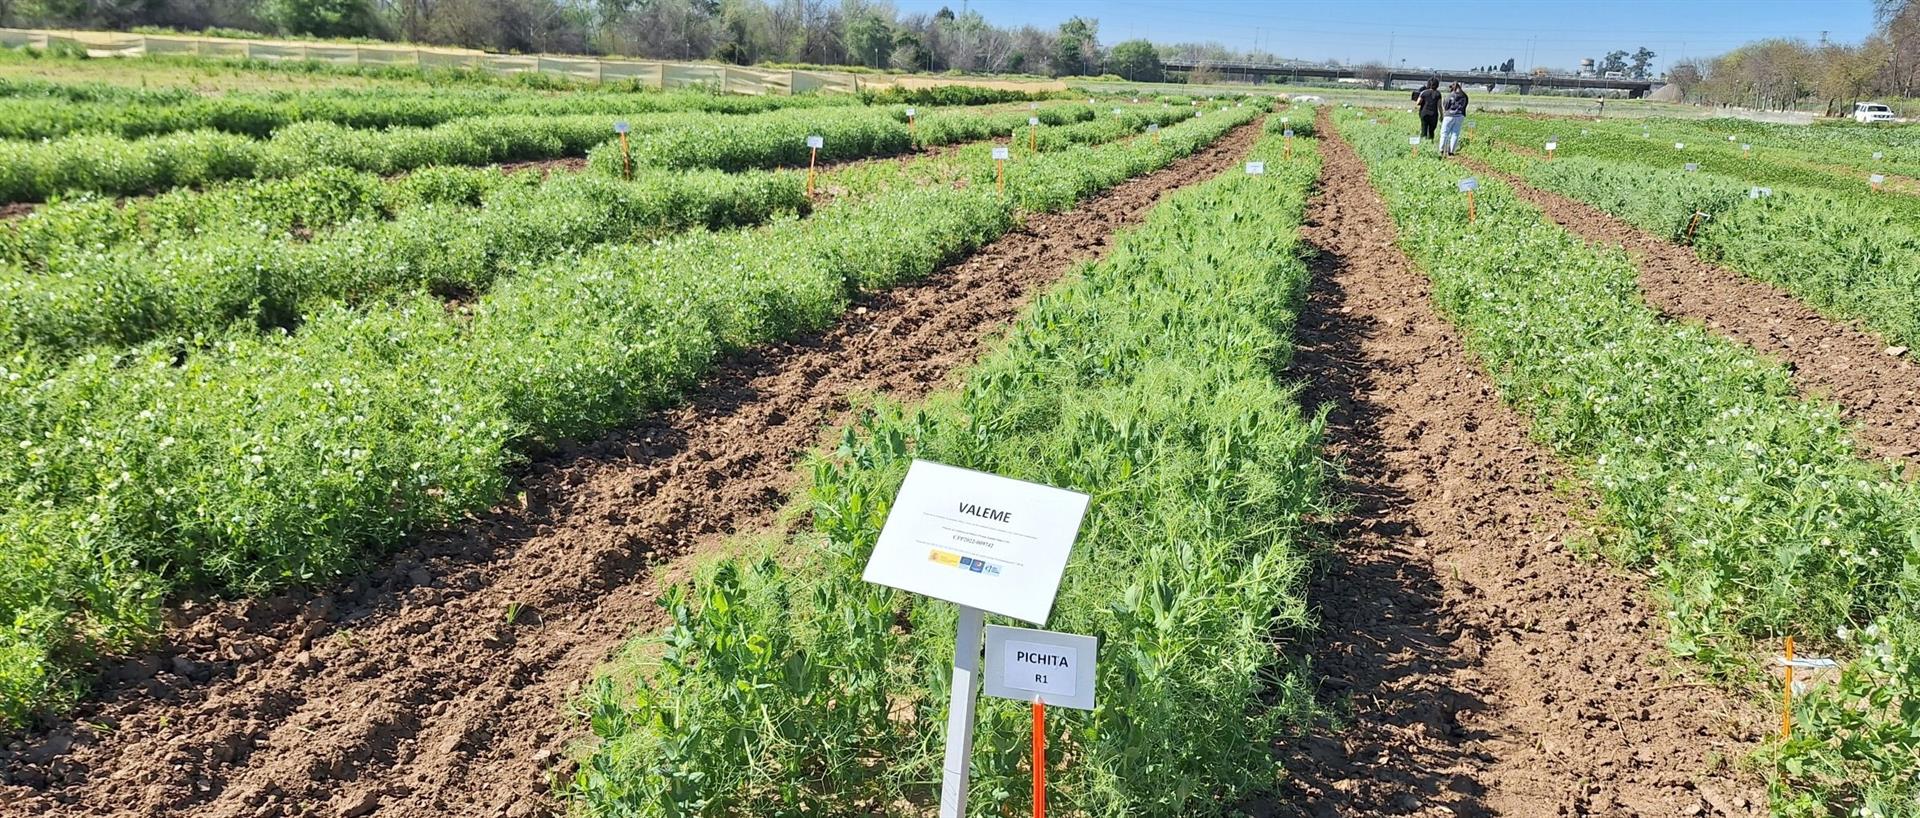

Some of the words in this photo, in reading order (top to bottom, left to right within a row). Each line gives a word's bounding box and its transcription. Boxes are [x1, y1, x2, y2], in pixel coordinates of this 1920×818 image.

[959, 501, 1012, 523] VALEME
[1017, 651, 1069, 668] PICHITA
[1035, 673, 1048, 684] R1
